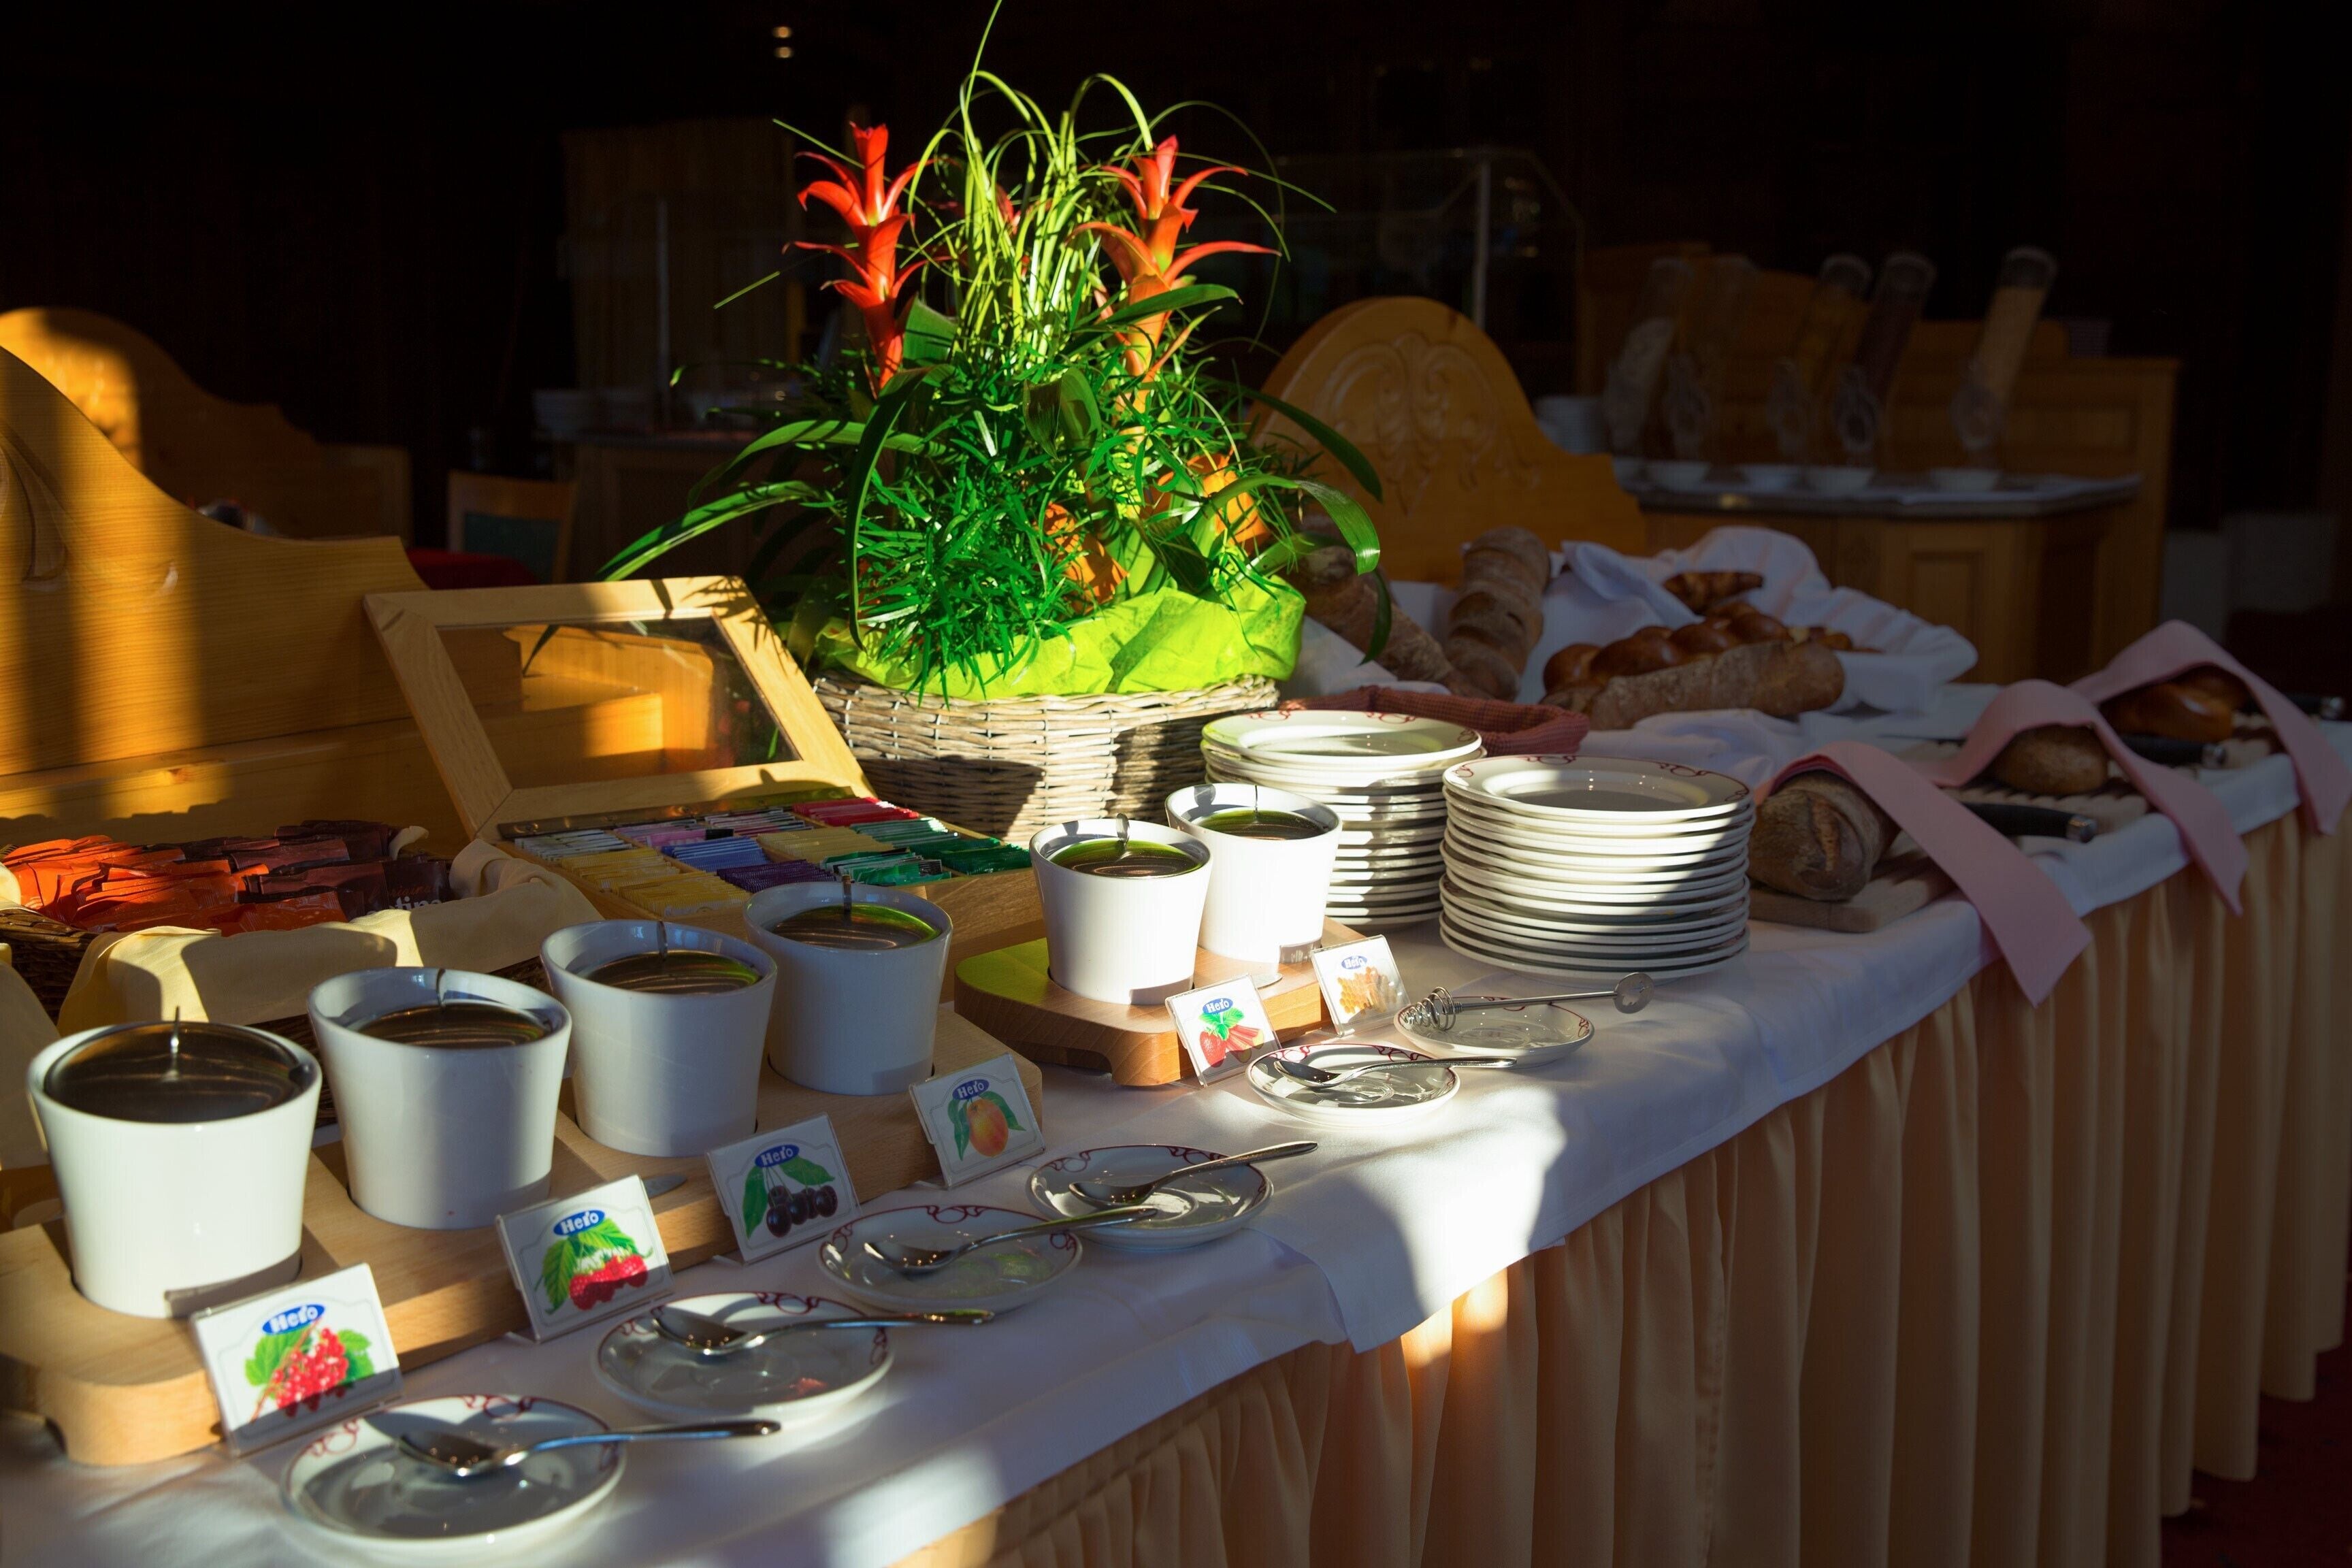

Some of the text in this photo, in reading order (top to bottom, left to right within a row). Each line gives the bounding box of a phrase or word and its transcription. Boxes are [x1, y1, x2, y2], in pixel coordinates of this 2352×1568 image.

[1206, 999, 1230, 1013] Hero
[958, 1081, 985, 1098] Hero
[761, 1146, 794, 1168] Hero
[561, 1211, 599, 1235] Hero
[270, 1305, 318, 1333] Hero
